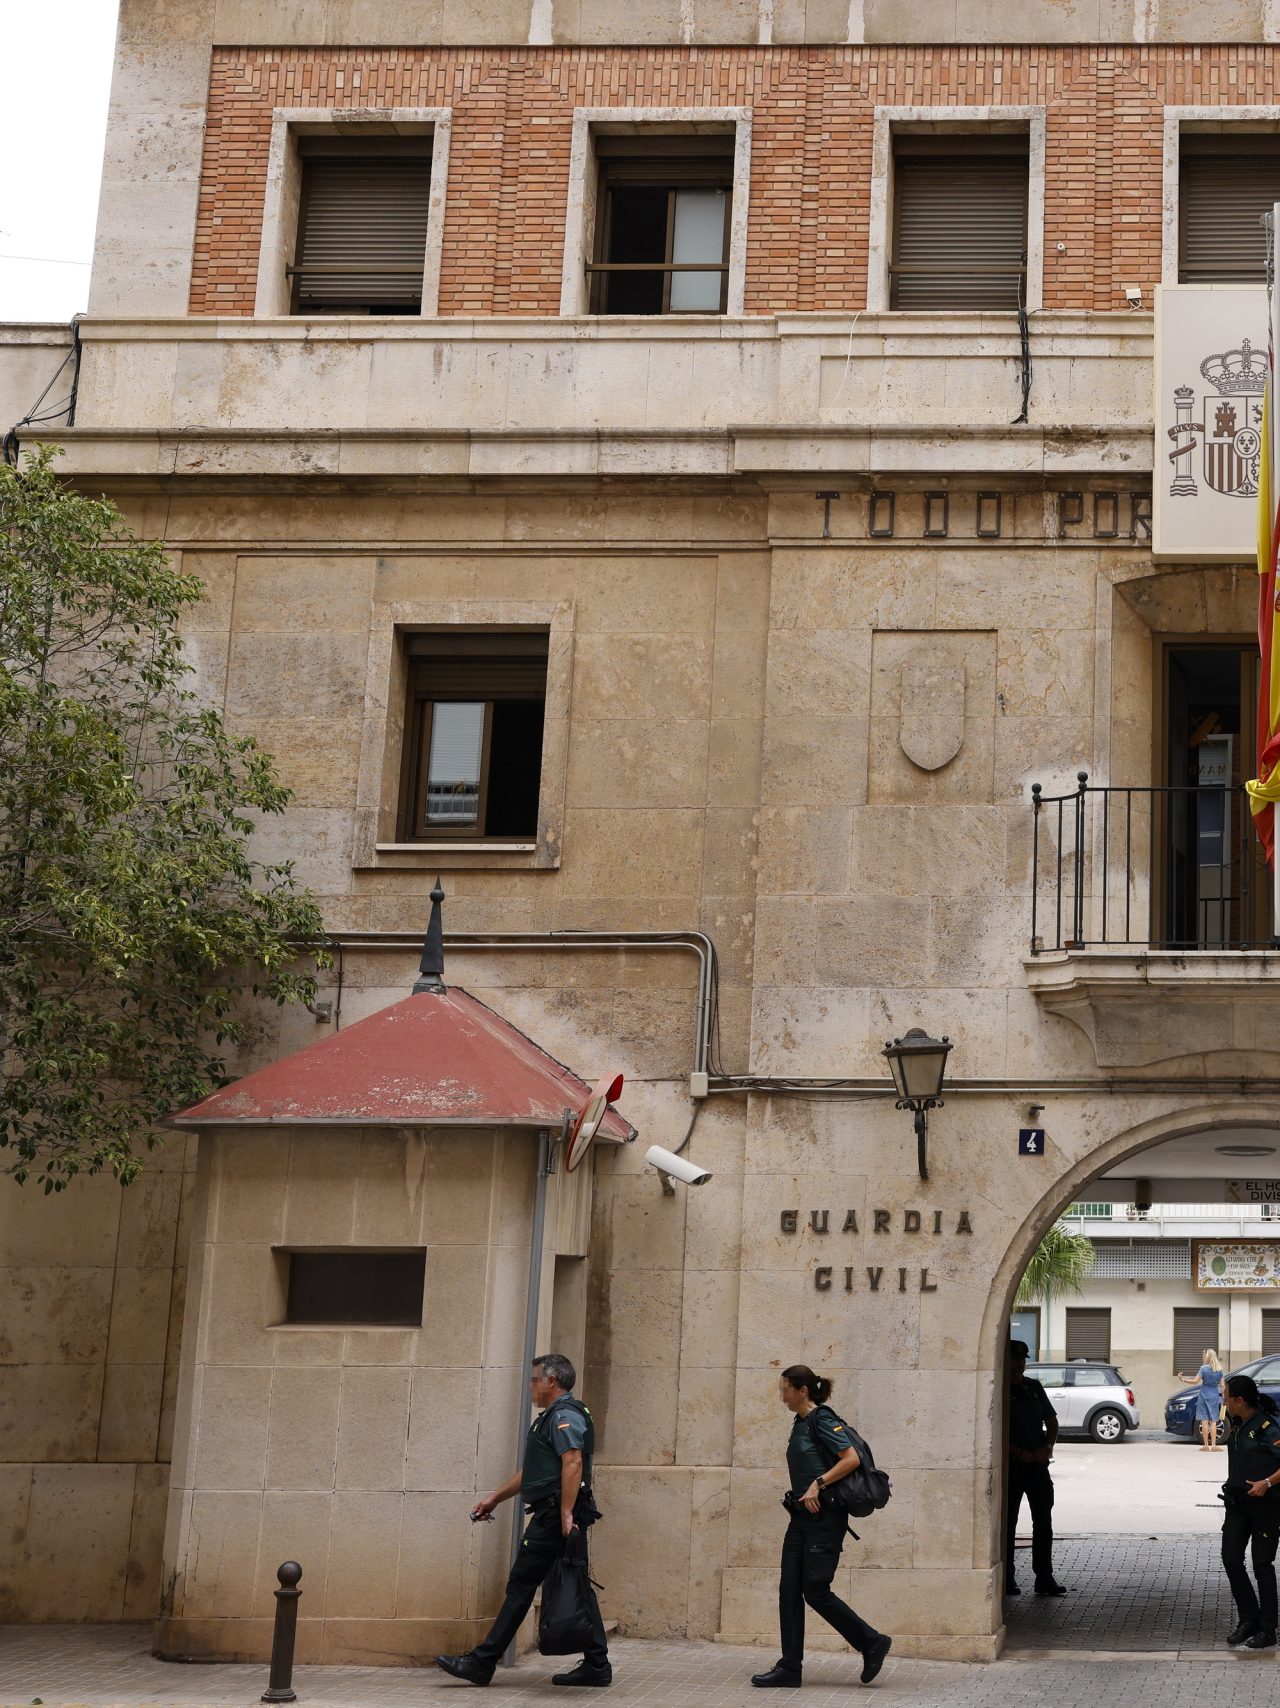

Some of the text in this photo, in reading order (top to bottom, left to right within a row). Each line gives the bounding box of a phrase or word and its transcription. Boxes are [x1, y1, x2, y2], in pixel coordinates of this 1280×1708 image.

[816, 491, 1000, 537] TODO
[1060, 491, 1153, 538] POR
[1026, 1132, 1037, 1152] 4
[1246, 1181, 1262, 1191] EL
[780, 1209, 974, 1234] GUARDIA
[814, 1266, 938, 1291] CIVIL
